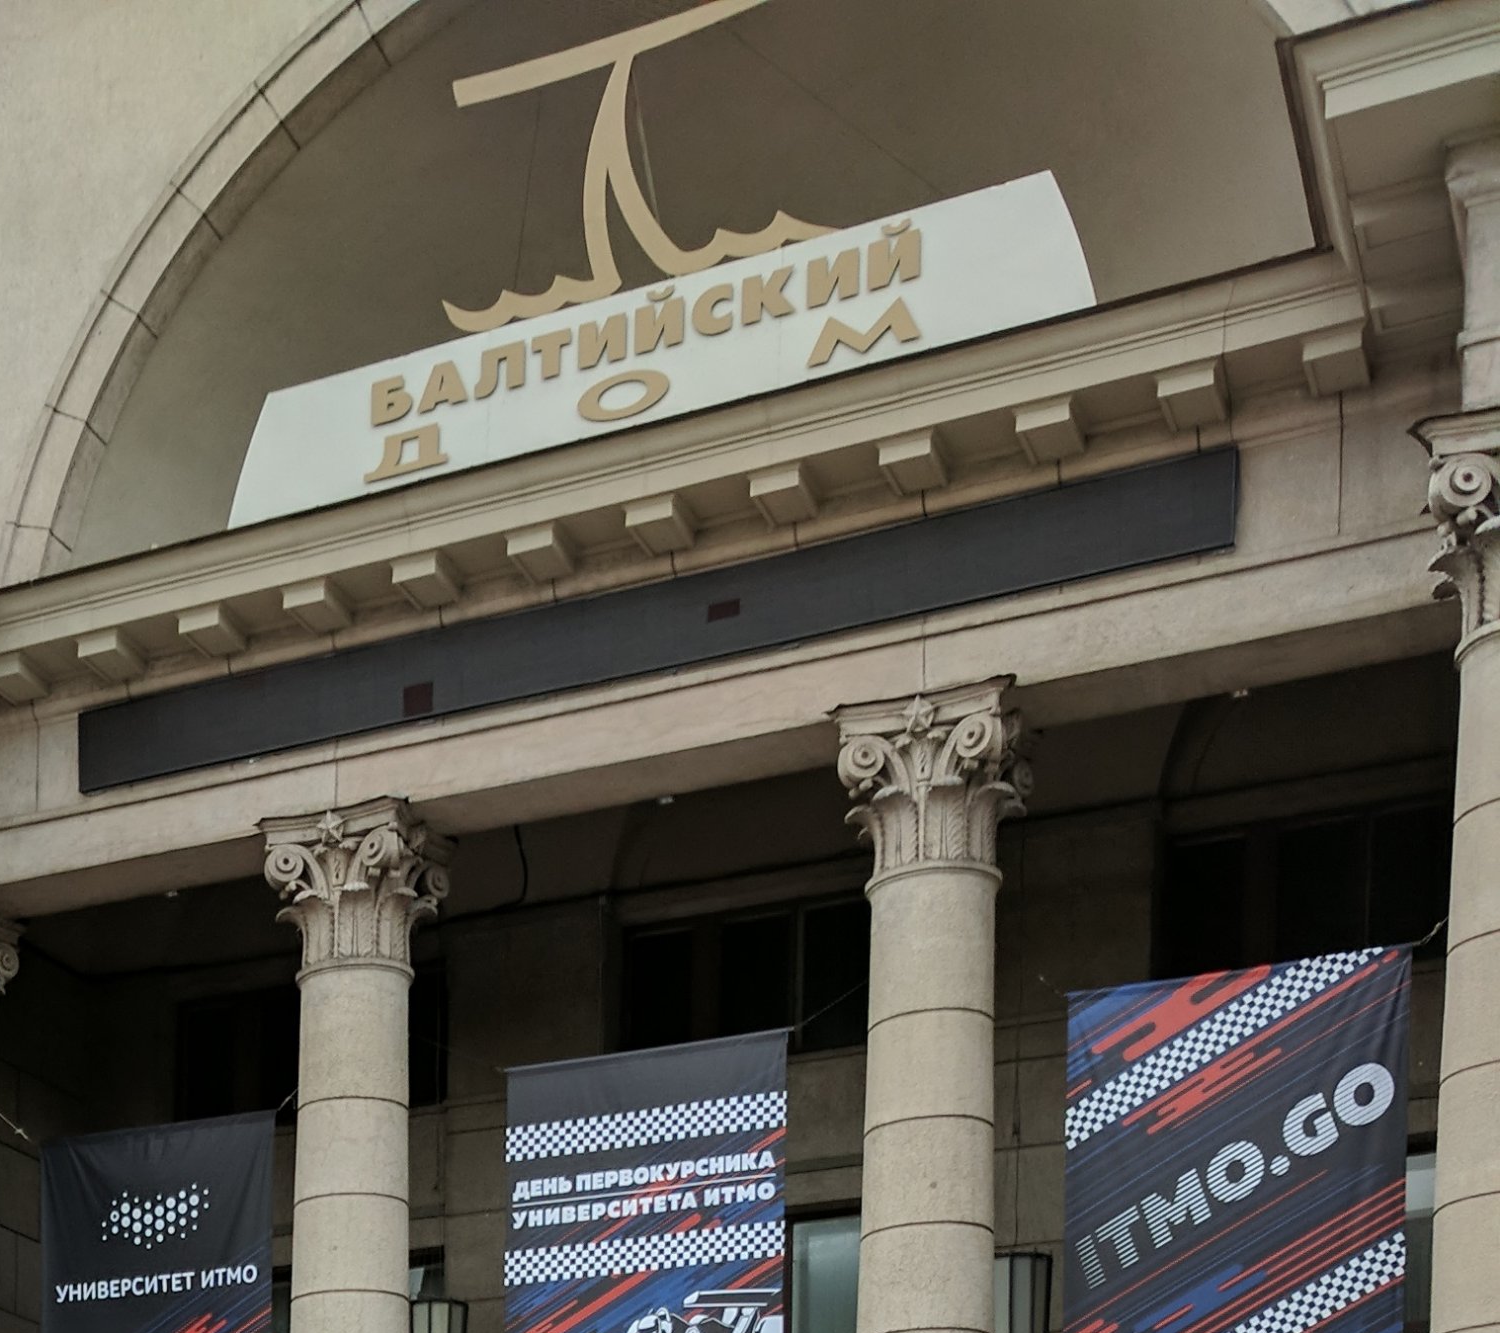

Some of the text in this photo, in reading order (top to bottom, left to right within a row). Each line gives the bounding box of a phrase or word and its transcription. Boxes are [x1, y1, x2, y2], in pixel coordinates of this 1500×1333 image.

[370, 217, 924, 427] БАЛТИЙСКИЙ
[363, 297, 922, 484] ДОМ
[512, 1151, 776, 1202] ДЕНЬ ПЕРВОКУРСНИКА
[512, 1182, 776, 1229] УНИВЕРСИТЕТА ИТМО
[1074, 1062, 1395, 1290] ITMO.GO
[56, 1264, 258, 1303] УНИВЕРСИТЕТ ИТМО
